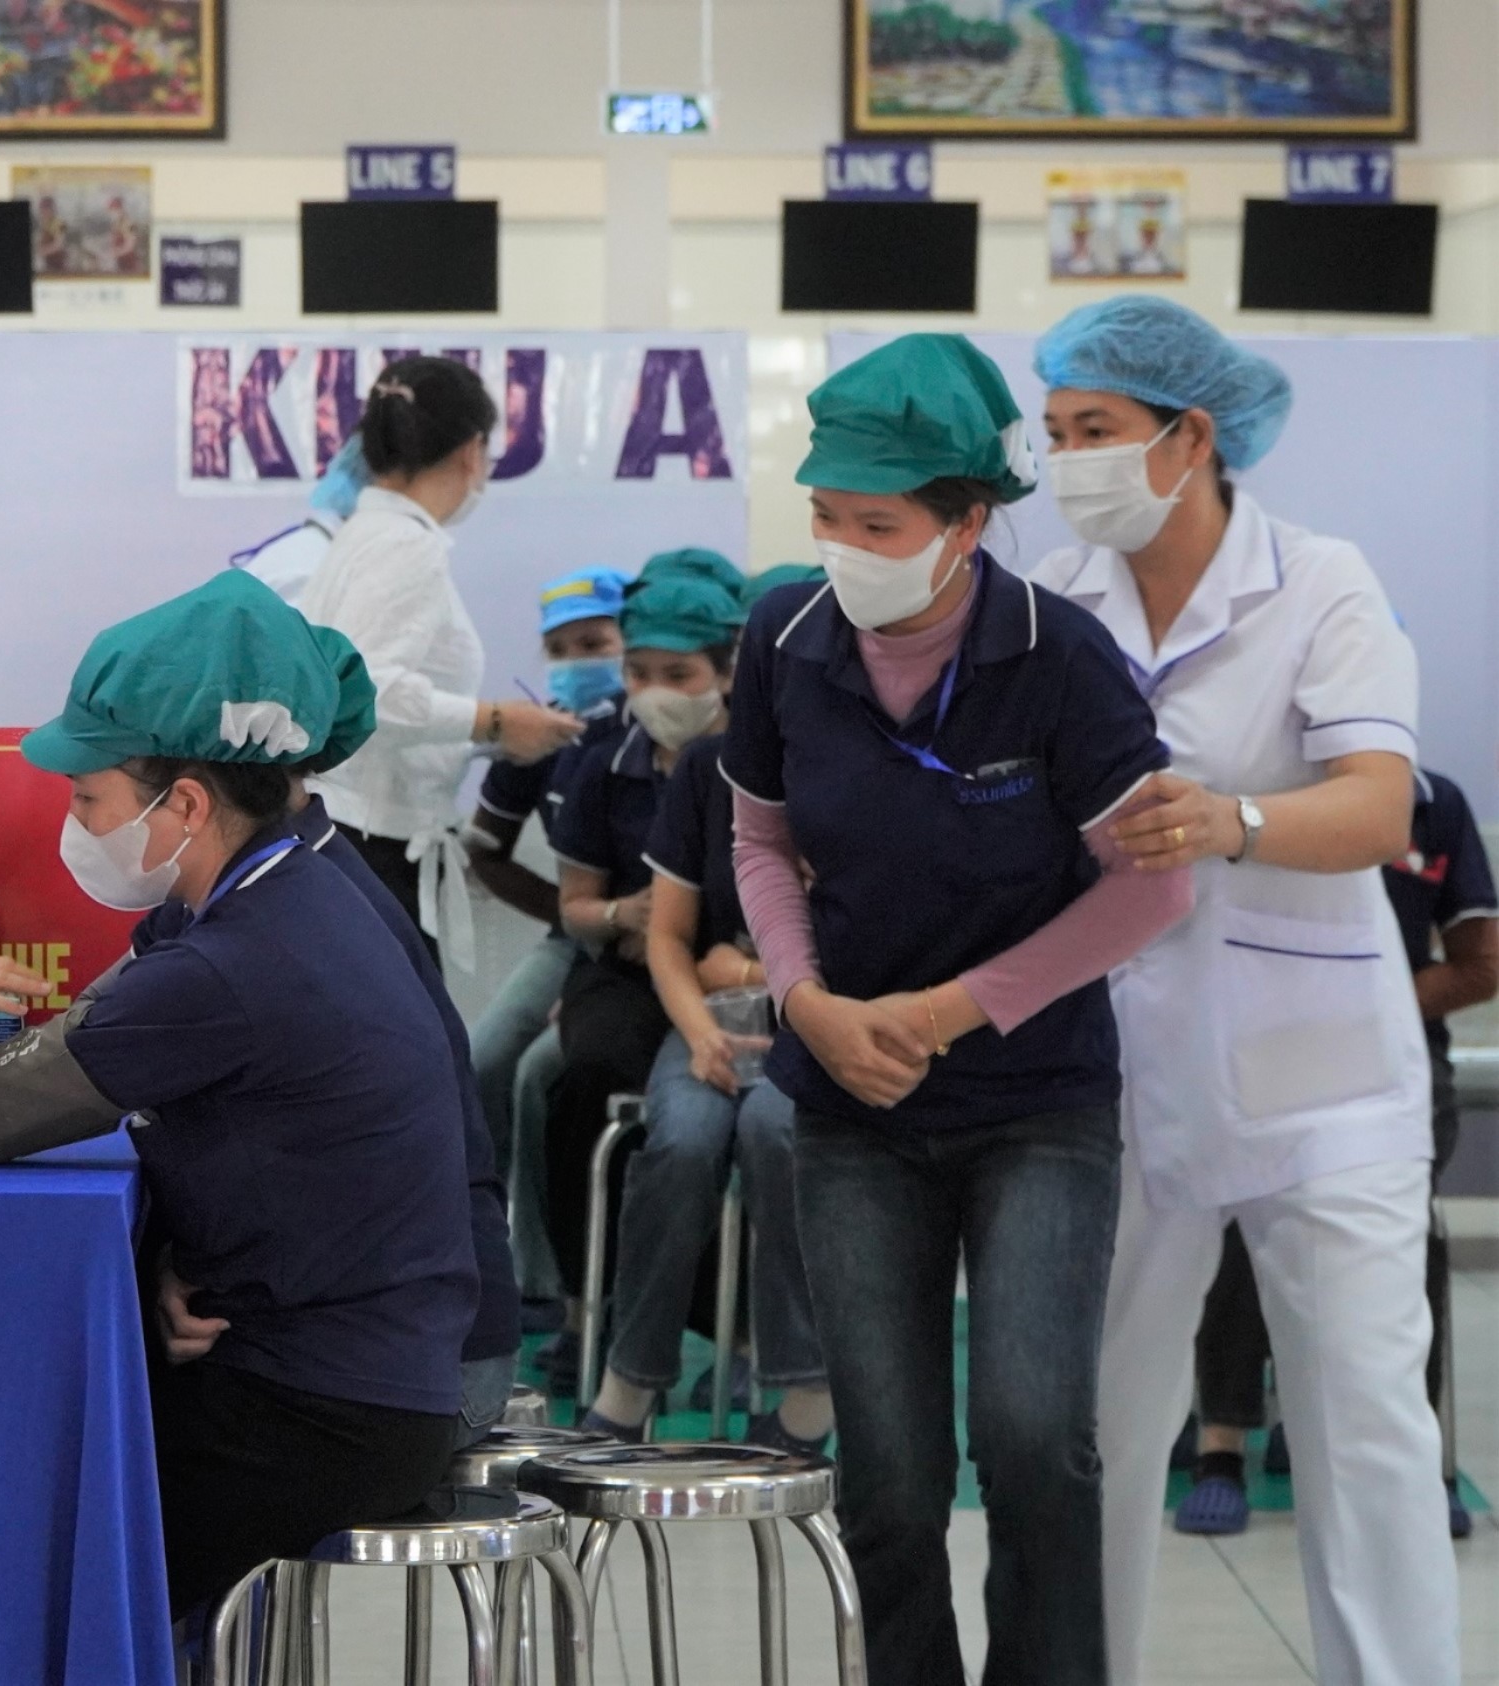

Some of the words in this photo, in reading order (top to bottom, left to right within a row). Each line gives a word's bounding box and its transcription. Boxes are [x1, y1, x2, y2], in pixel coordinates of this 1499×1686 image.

[349, 153, 422, 190] LINE
[430, 153, 453, 190] 5
[827, 154, 897, 191] LINE
[907, 154, 929, 191] 6
[1290, 156, 1361, 193] LINE
[1369, 156, 1390, 192] 7
[614, 348, 733, 479] A
